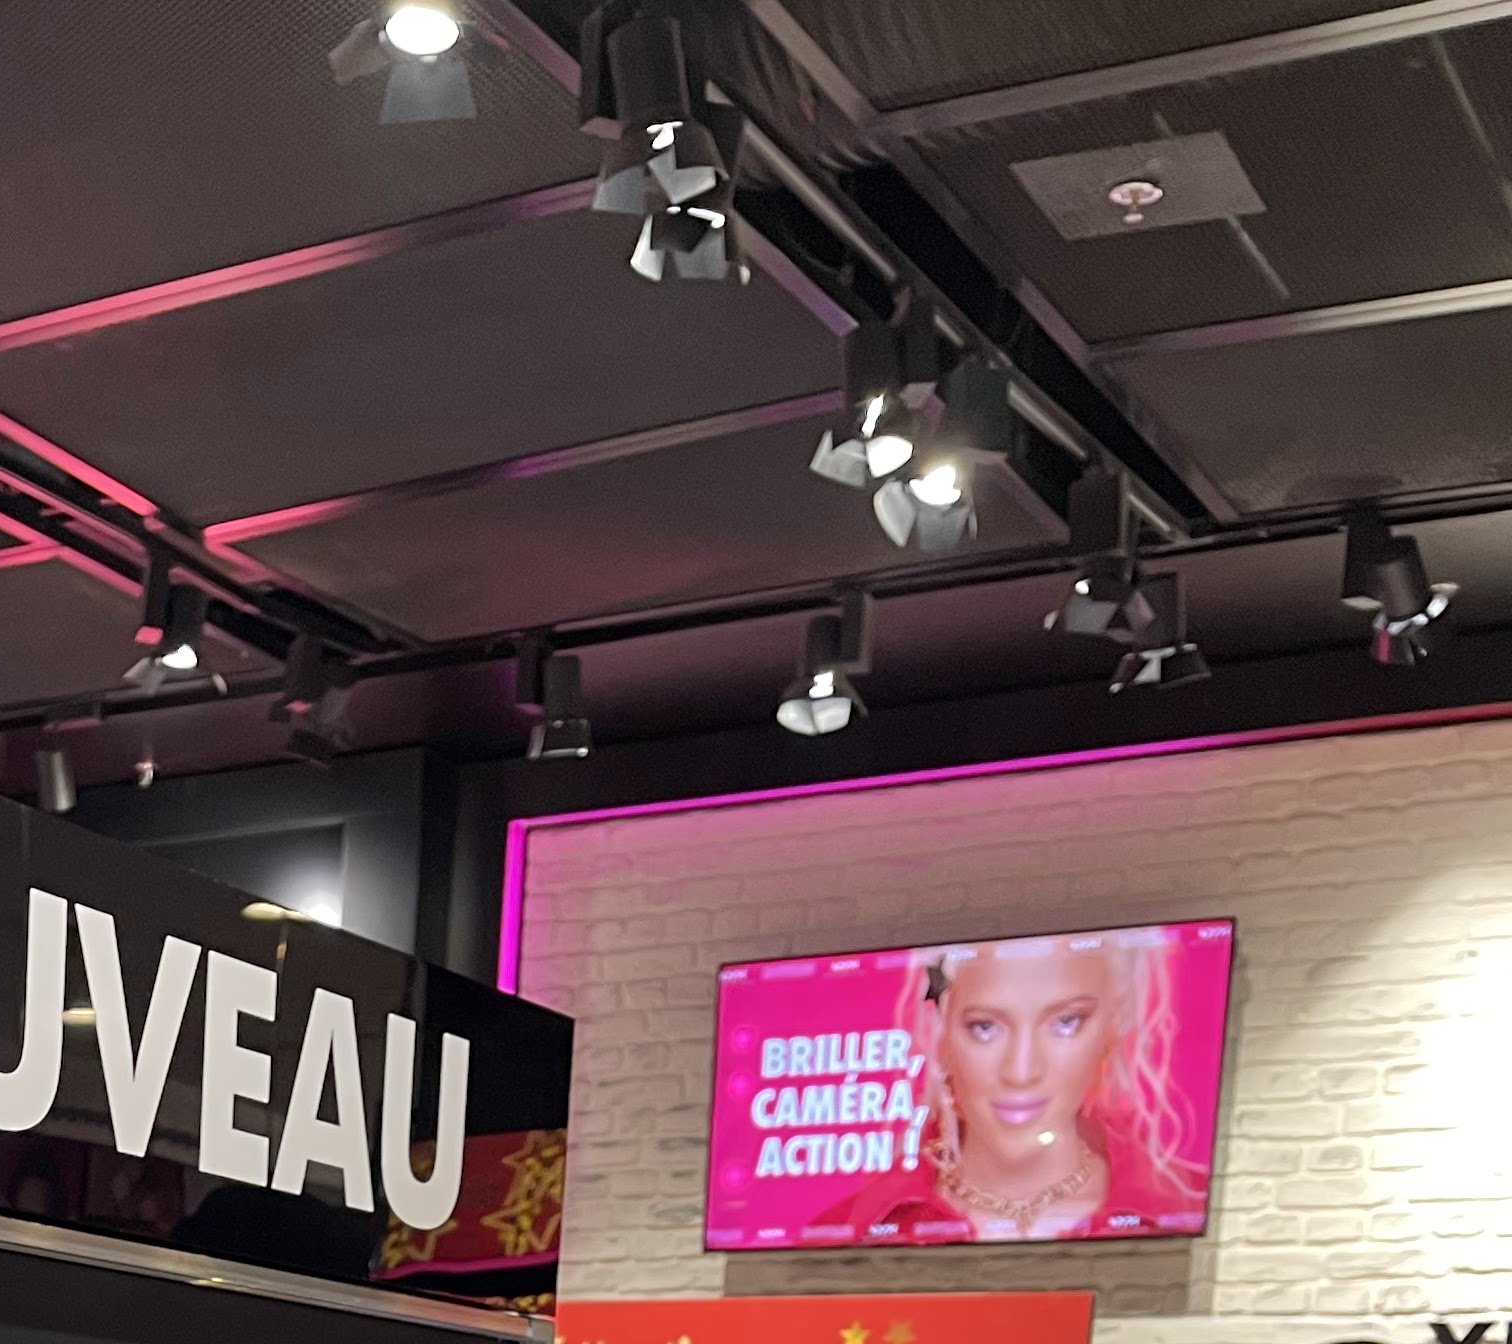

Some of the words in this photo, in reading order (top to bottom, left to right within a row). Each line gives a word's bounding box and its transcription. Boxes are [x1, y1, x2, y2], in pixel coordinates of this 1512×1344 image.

[760, 1029, 925, 1079] BRILLER,
[750, 1072, 929, 1129] CAMÉRA,
[755, 1132, 893, 1179] ACTION
